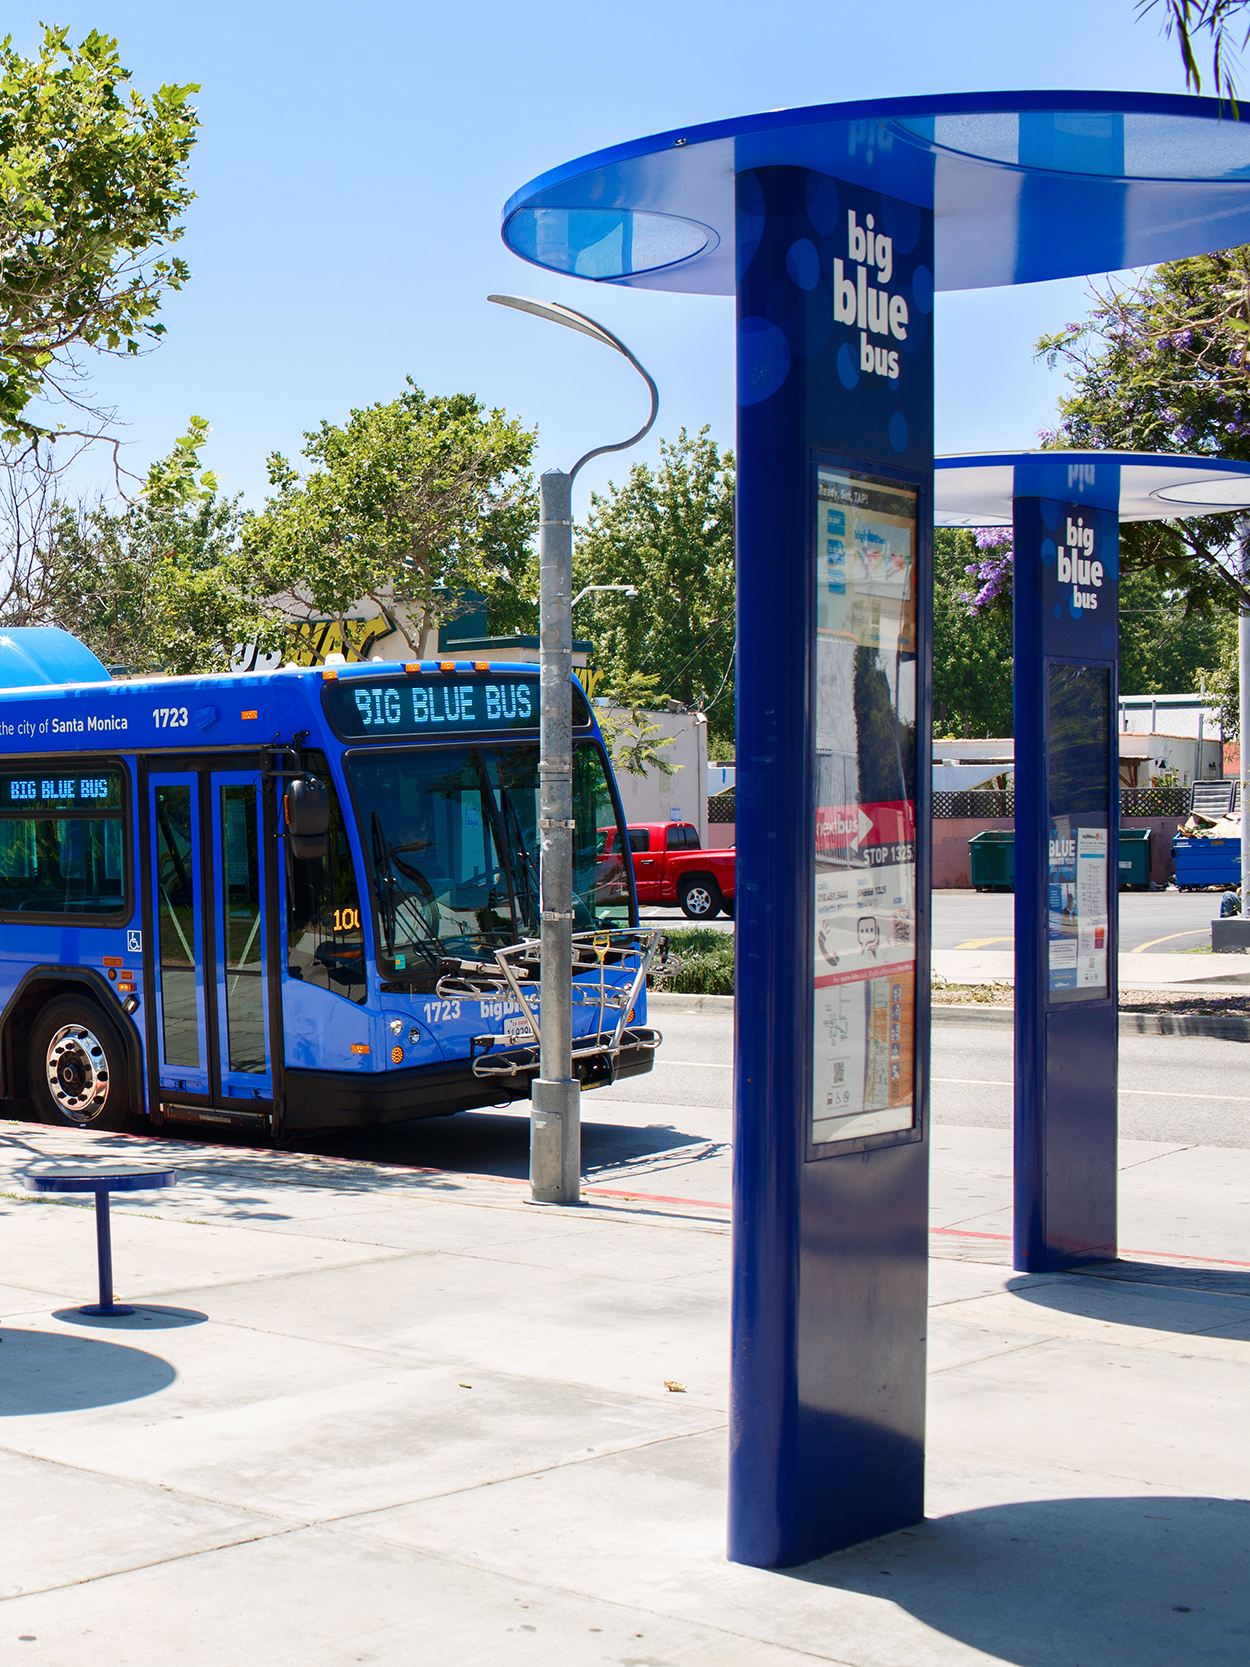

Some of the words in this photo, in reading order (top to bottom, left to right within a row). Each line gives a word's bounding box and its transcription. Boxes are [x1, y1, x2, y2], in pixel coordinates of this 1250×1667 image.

[848, 209, 893, 284] big
[833, 257, 909, 341] blue
[860, 331, 900, 379] bus
[853, 491, 869, 505] TAP!
[1066, 517, 1094, 556] big
[1058, 545, 1103, 587] blue
[1073, 585, 1098, 610] bus
[354, 688, 401, 725] BIG
[411, 685, 476, 723] BLUE
[485, 684, 532, 719] BUS
[16, 719, 36, 738] city
[38, 718, 49, 734] of
[51, 718, 84, 733] Santa
[87, 715, 128, 732] Monica
[152, 707, 189, 728] 1723
[10, 781, 37, 799] BIG
[41, 780, 75, 799] BLUE
[80, 779, 108, 798] BUS
[863, 847, 889, 866] STOP
[890, 844, 913, 862] 1325
[1048, 839, 1076, 858] BLUE
[423, 1000, 461, 1023] 1723
[480, 1000, 503, 1021] big
